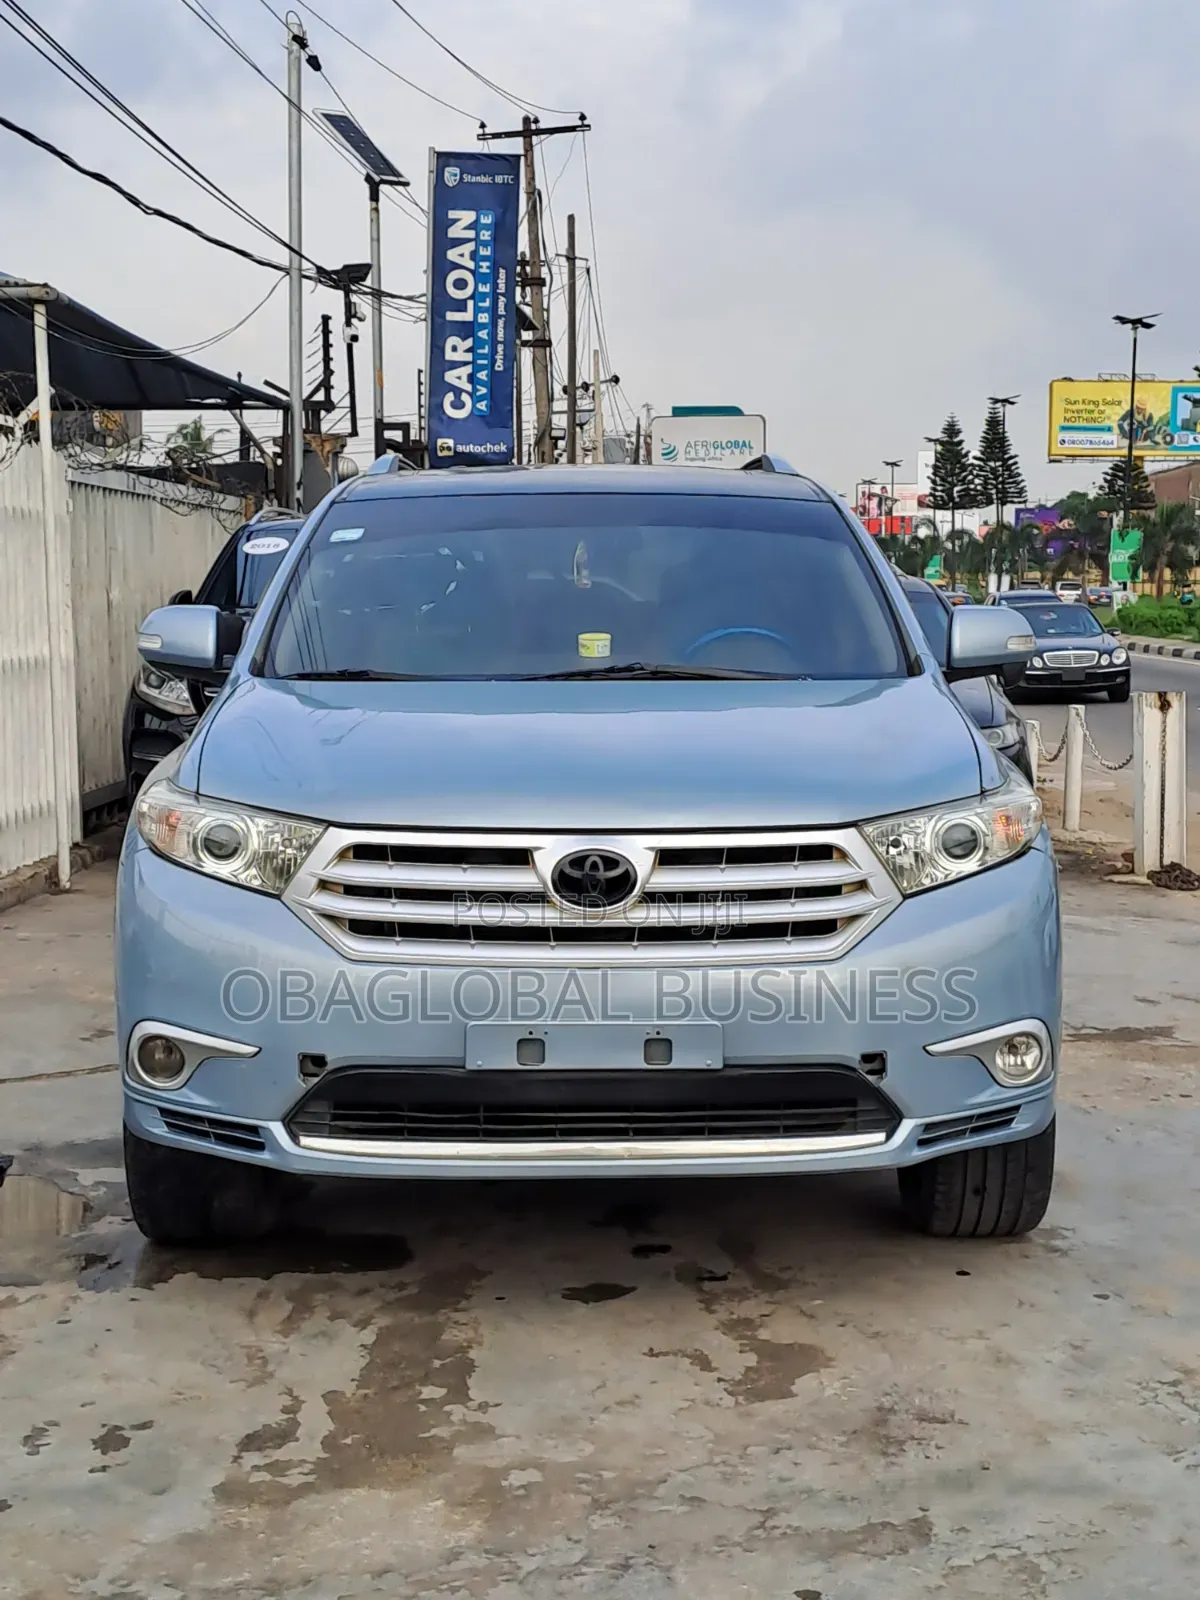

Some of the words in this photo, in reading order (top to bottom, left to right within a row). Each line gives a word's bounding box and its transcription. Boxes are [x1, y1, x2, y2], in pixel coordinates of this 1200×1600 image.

[462, 173, 493, 183] Stanbic
[479, 214, 492, 273] HERE
[445, 209, 477, 322] LOAN
[496, 267, 506, 293] later
[498, 295, 507, 315] pay
[475, 282, 491, 412] AVAILABLE
[494, 343, 504, 371] Drive
[443, 335, 474, 419] CAR
[1064, 398, 1080, 406] Sun
[1081, 398, 1100, 408] King
[1102, 398, 1122, 406] Solar
[1064, 407, 1096, 415] Inverter
[456, 441, 508, 453] autochek
